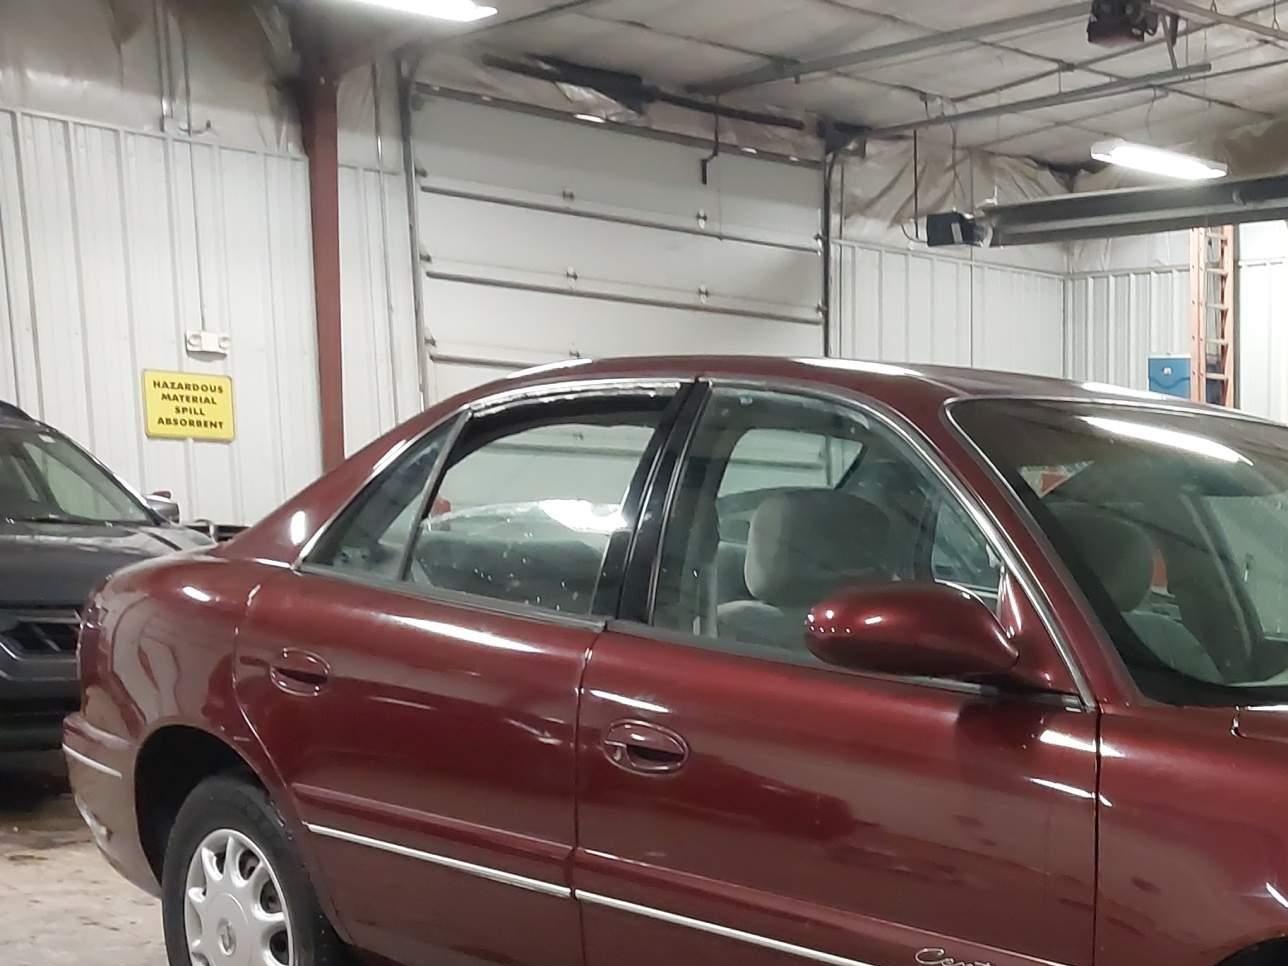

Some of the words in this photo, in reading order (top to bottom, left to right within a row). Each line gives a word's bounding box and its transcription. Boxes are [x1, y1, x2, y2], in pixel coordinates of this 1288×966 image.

[153, 380, 223, 394] HAZARDOUS
[161, 393, 217, 405] MATERIAL
[175, 406, 205, 416] SPILL
[157, 417, 224, 429] ABSORBENT
